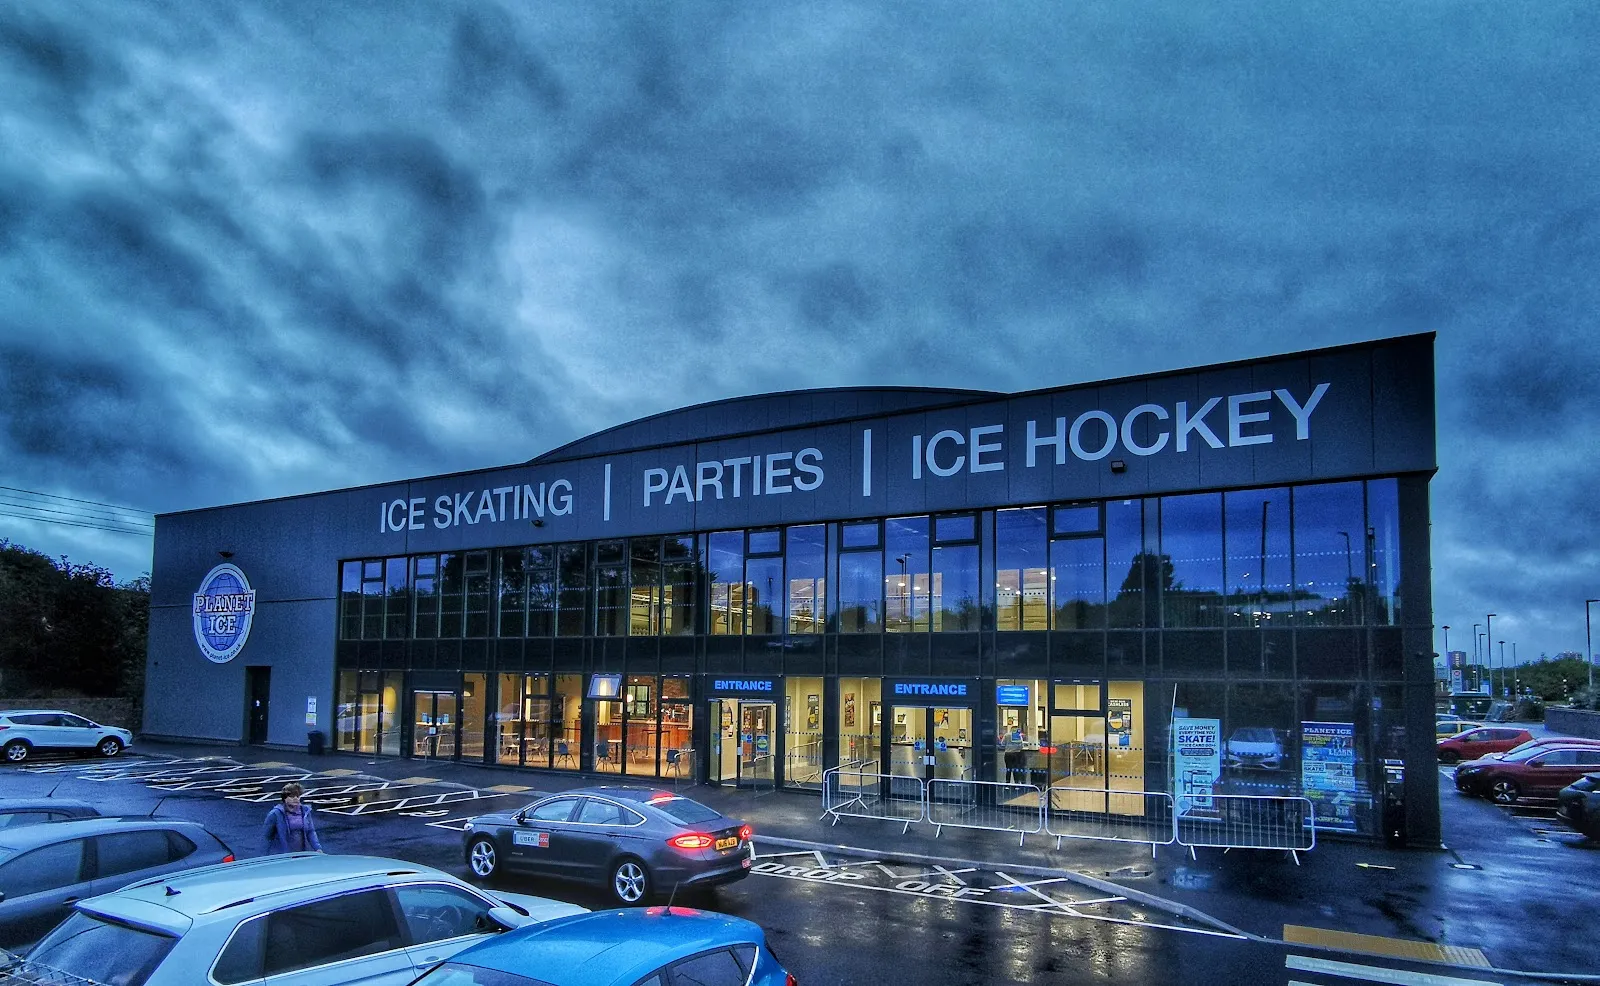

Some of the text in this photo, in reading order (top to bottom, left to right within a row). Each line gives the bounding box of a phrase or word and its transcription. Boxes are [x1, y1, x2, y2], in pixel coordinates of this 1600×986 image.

[912, 382, 1331, 480] ICE HOCKEY
[643, 447, 824, 507] PARTIES
[381, 479, 573, 533] ICE SKATING
[195, 593, 253, 613] PLANET
[208, 615, 236, 634] ICE
[714, 680, 772, 691] ENTRANCE
[894, 683, 967, 695] ENTRANCE
[1178, 735, 1216, 743] SKATE!
[750, 862, 865, 882] DROP
[895, 880, 991, 898] OFF
